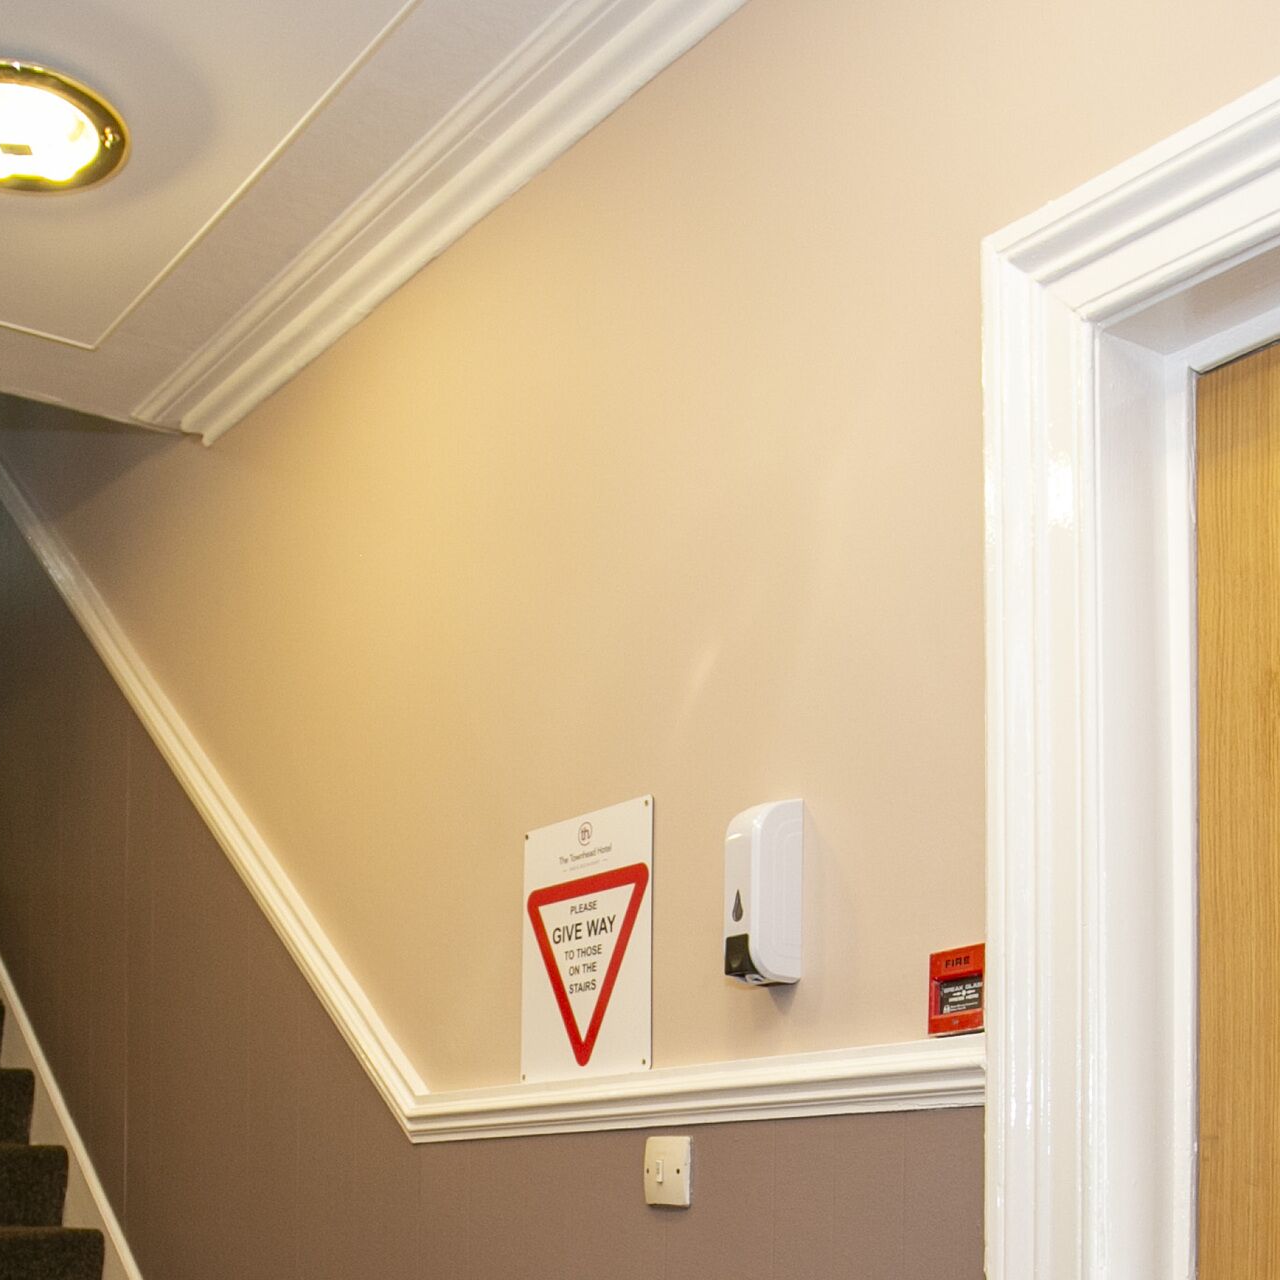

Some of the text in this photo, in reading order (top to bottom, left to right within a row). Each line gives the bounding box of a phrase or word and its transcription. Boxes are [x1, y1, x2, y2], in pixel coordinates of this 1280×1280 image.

[570, 900, 598, 915] PLEASE
[552, 914, 617, 945] GIVE WAY
[564, 943, 603, 961] TO THOSE
[568, 961, 597, 977] ON THE
[945, 955, 970, 968] FIRE
[569, 979, 597, 995] STAIRS
